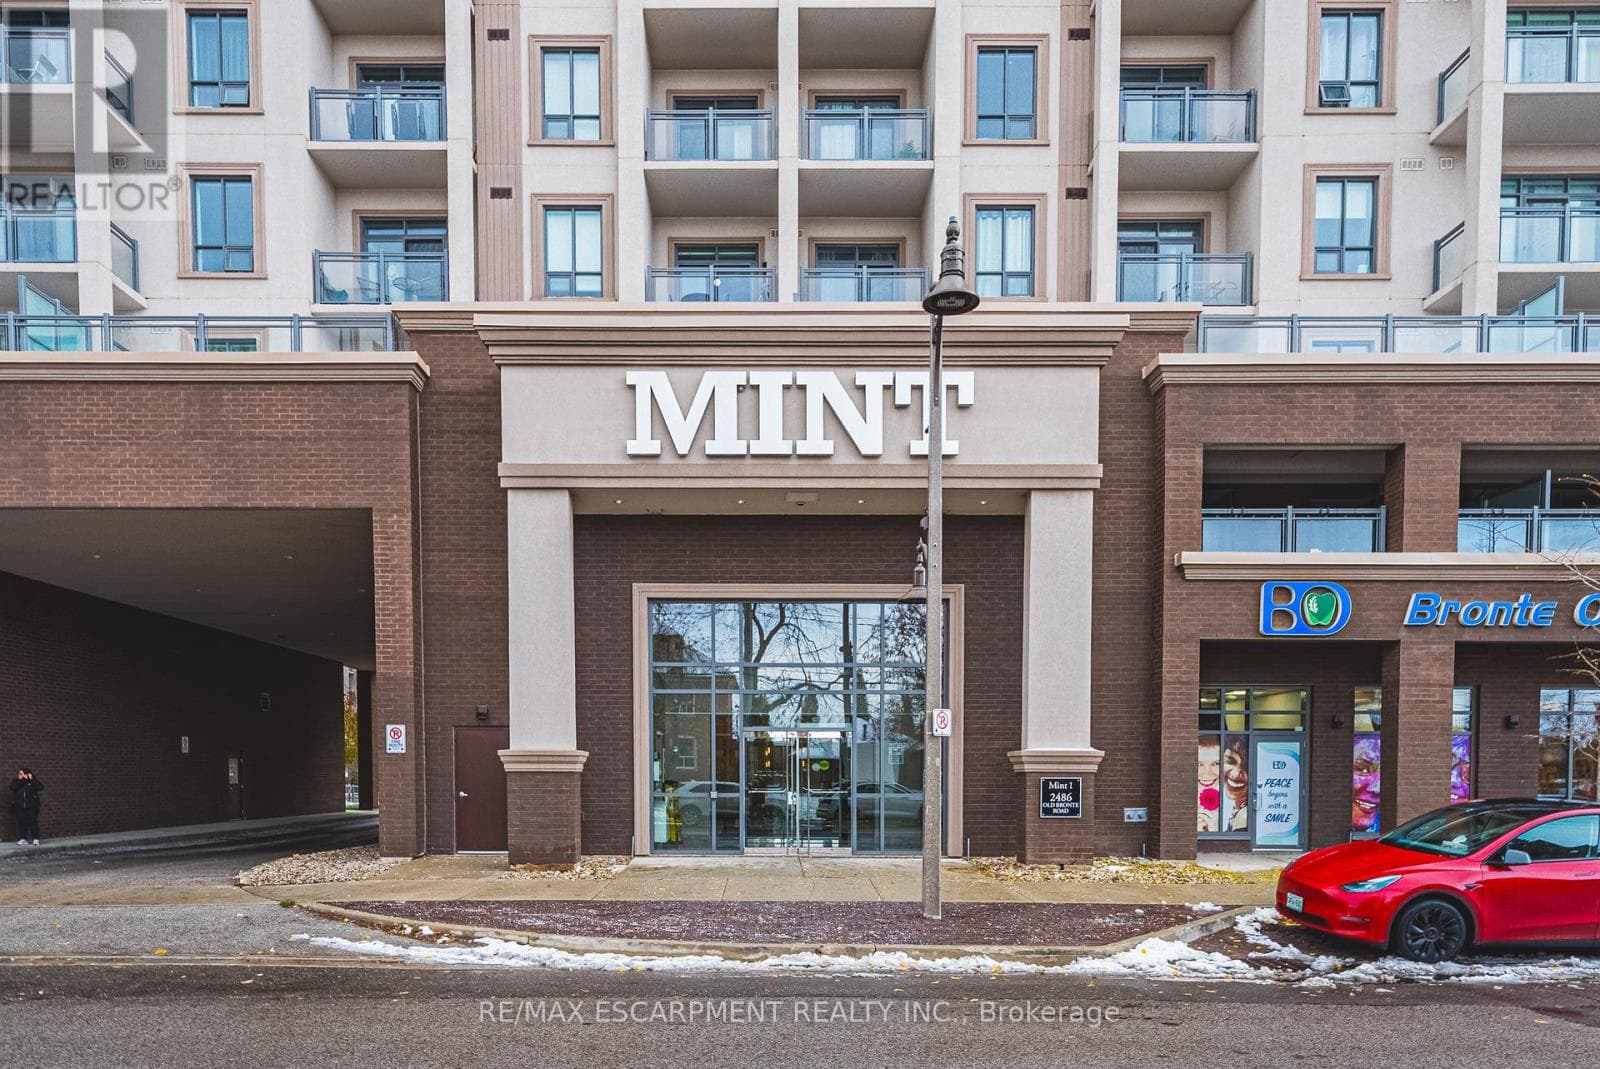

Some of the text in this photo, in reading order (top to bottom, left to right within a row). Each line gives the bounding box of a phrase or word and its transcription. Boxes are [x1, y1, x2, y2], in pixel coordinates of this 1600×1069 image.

[626, 371, 975, 455] MINT
[1403, 592, 1558, 627] Bronte
[1048, 781, 1068, 789] Mint
[1264, 778, 1293, 788] PEACE
[1049, 792, 1073, 802] 2486
[1264, 813, 1292, 822] SMILE
